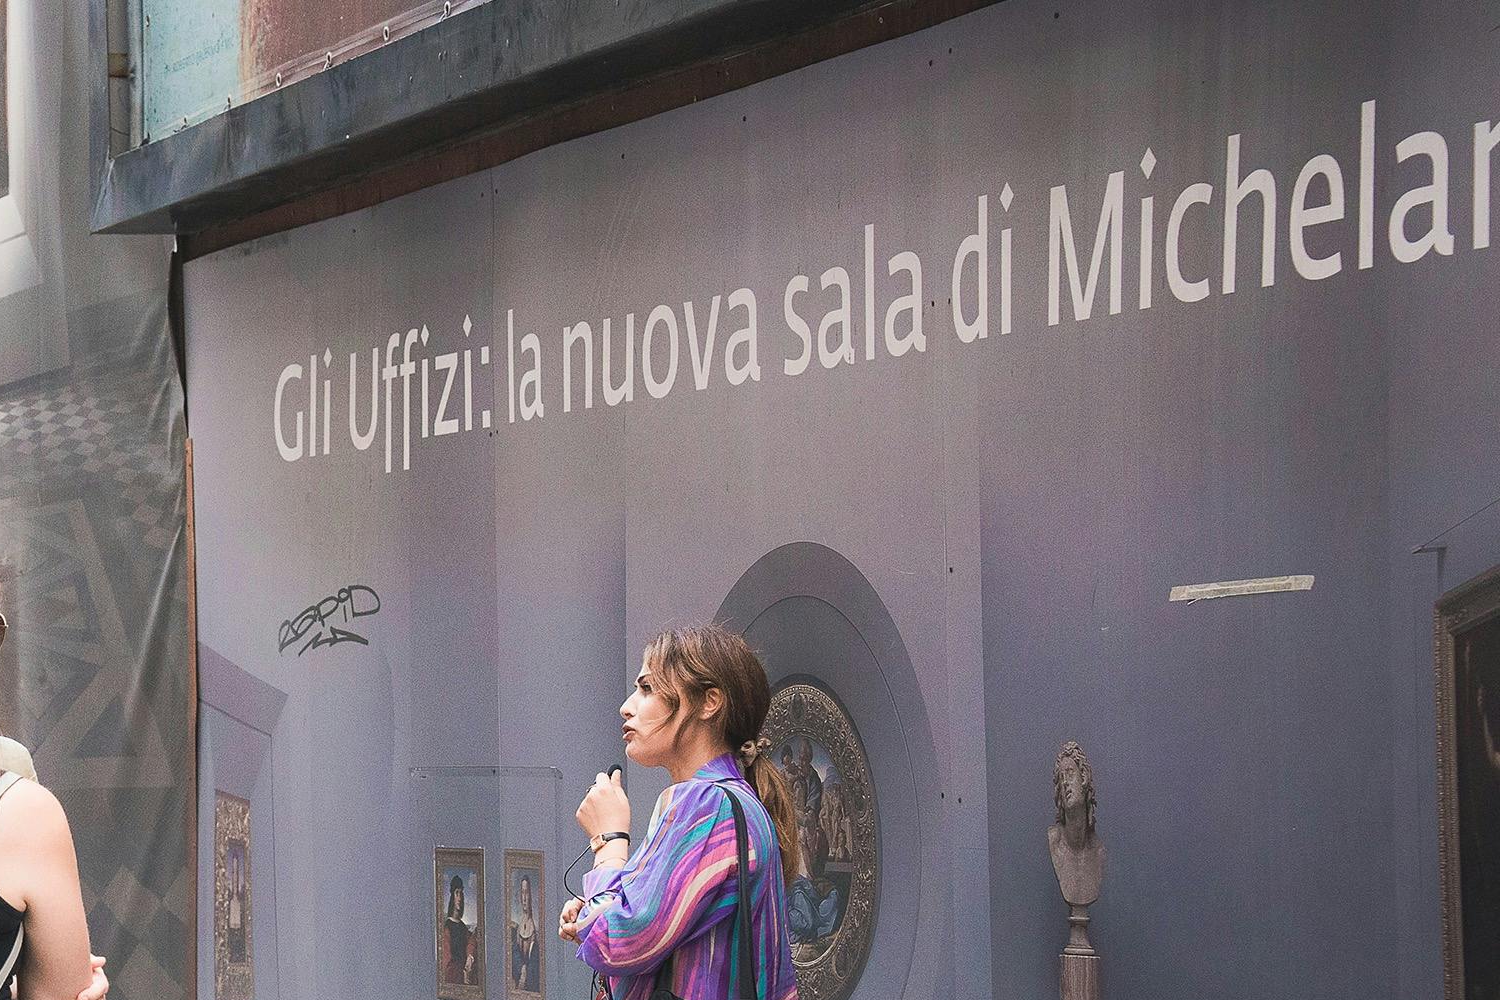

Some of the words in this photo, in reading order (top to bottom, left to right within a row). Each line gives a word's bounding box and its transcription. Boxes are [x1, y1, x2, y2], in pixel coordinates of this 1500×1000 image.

[273, 347, 332, 463] Gli
[349, 314, 491, 473] Uffizi:
[507, 308, 544, 424] la
[562, 286, 761, 413] nuova
[783, 223, 927, 376] sala
[951, 182, 1015, 343] di
